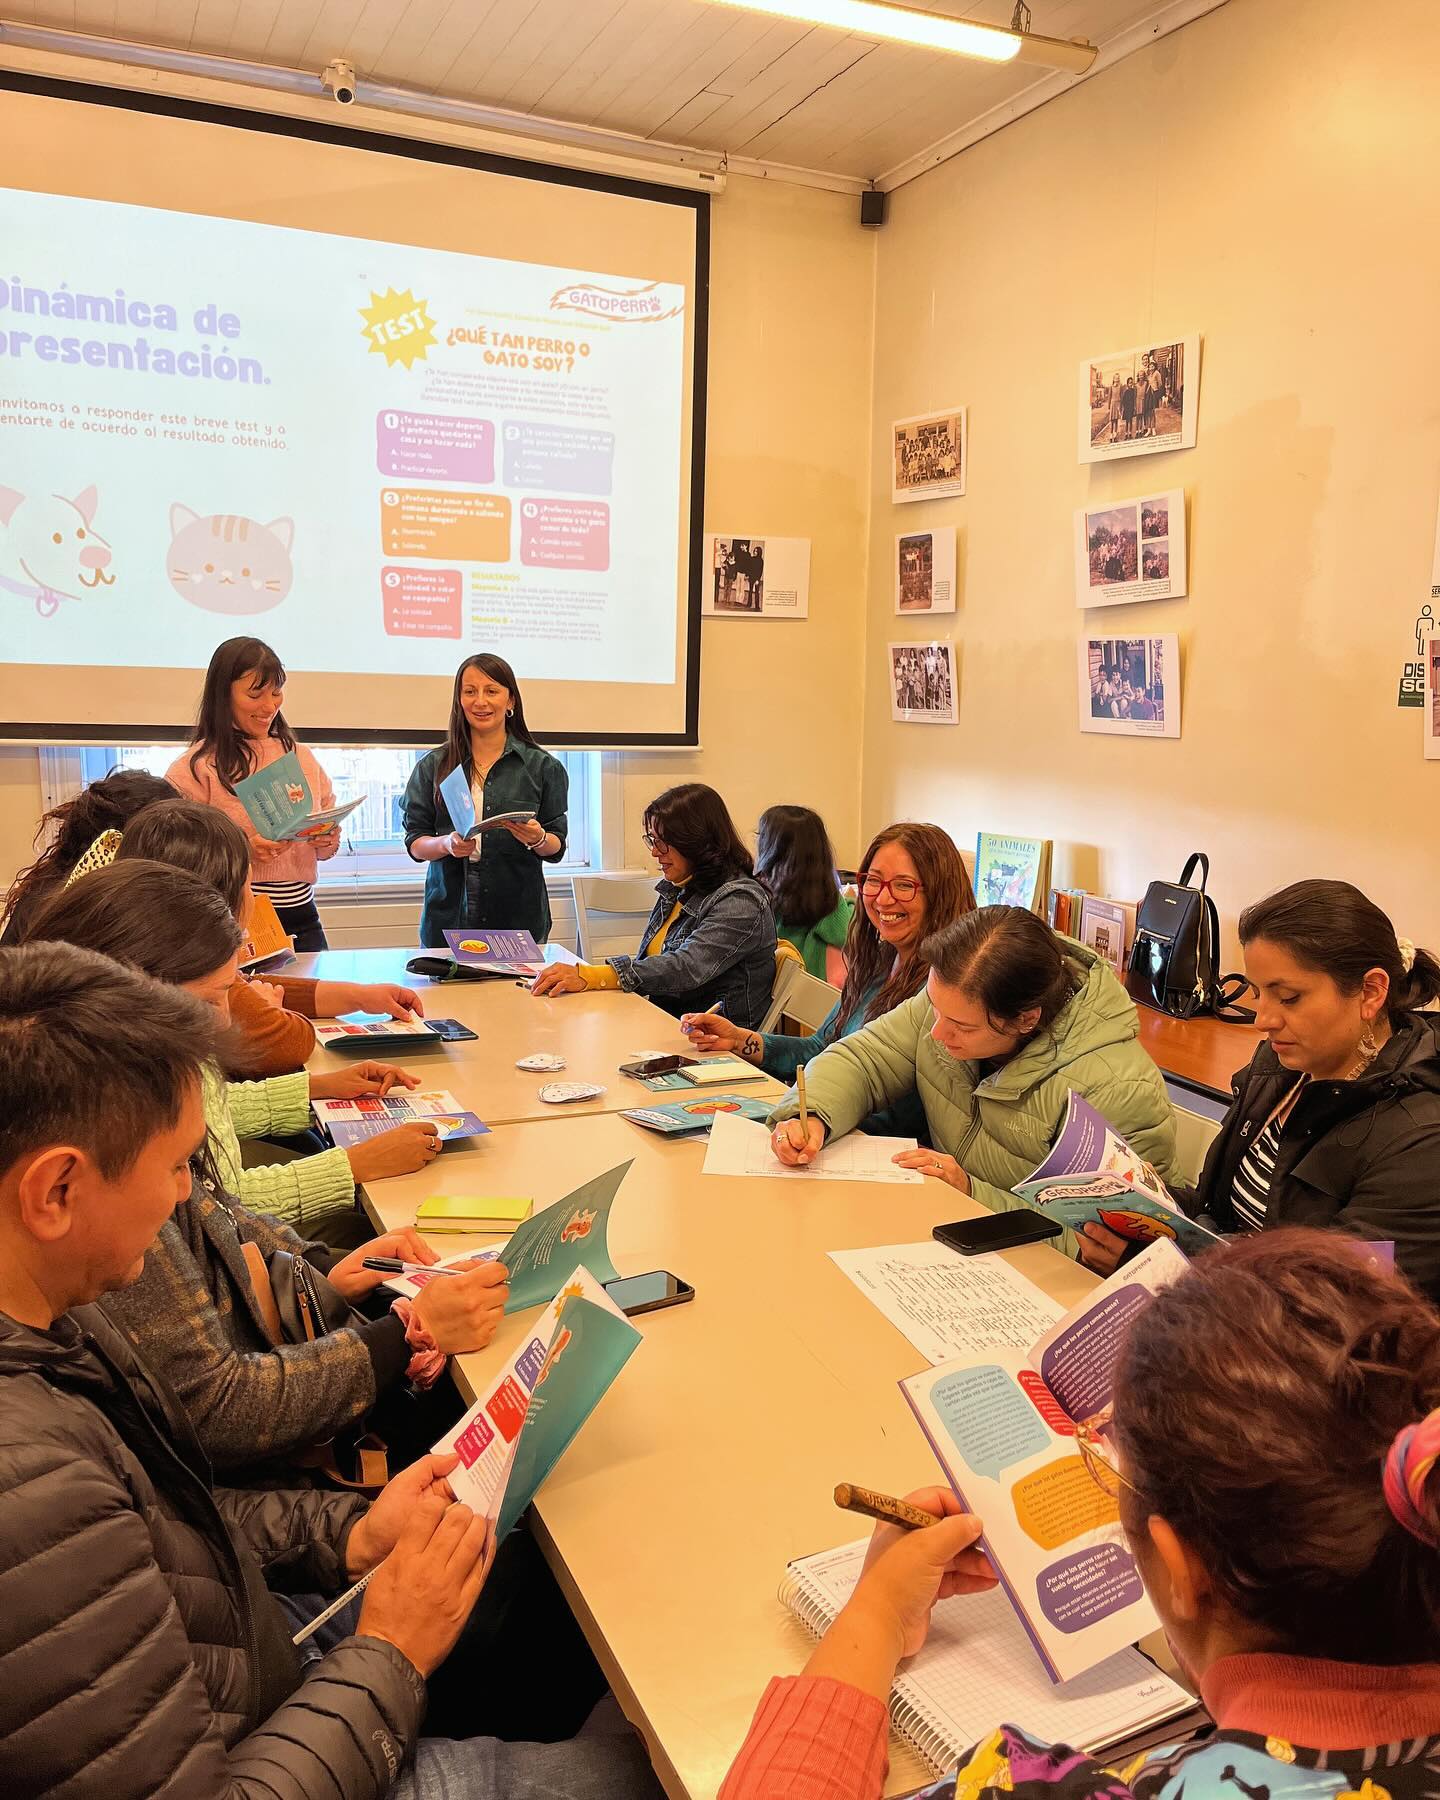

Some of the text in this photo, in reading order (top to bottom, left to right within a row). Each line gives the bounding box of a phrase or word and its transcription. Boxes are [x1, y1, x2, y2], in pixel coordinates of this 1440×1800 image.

[193, 303, 240, 338] de
[370, 308, 425, 345] TEST
[447, 326, 590, 357] ¿QUÉ TAN PERRO O
[483, 350, 528, 369] GATO
[59, 417, 75, 429] de
[82, 421, 137, 436] acuerdo
[145, 426, 156, 437] al
[163, 429, 225, 444] resultado
[71, 405, 285, 435] a responder este breve test y a
[1076, 1324, 1092, 1338] perros
[1045, 1575, 1061, 1589] ¿Por
[1058, 1569, 1071, 1582] qué
[1070, 1566, 1078, 1574] los
[1078, 1557, 1096, 1571] perros
[1095, 1549, 1111, 1561] rascan
[1052, 1581, 1067, 1594] suelo
[1067, 1569, 1090, 1586] después
[1088, 1566, 1096, 1574] de
[1073, 1569, 1108, 1592] necesidades?
[1059, 1614, 1068, 1622] con
